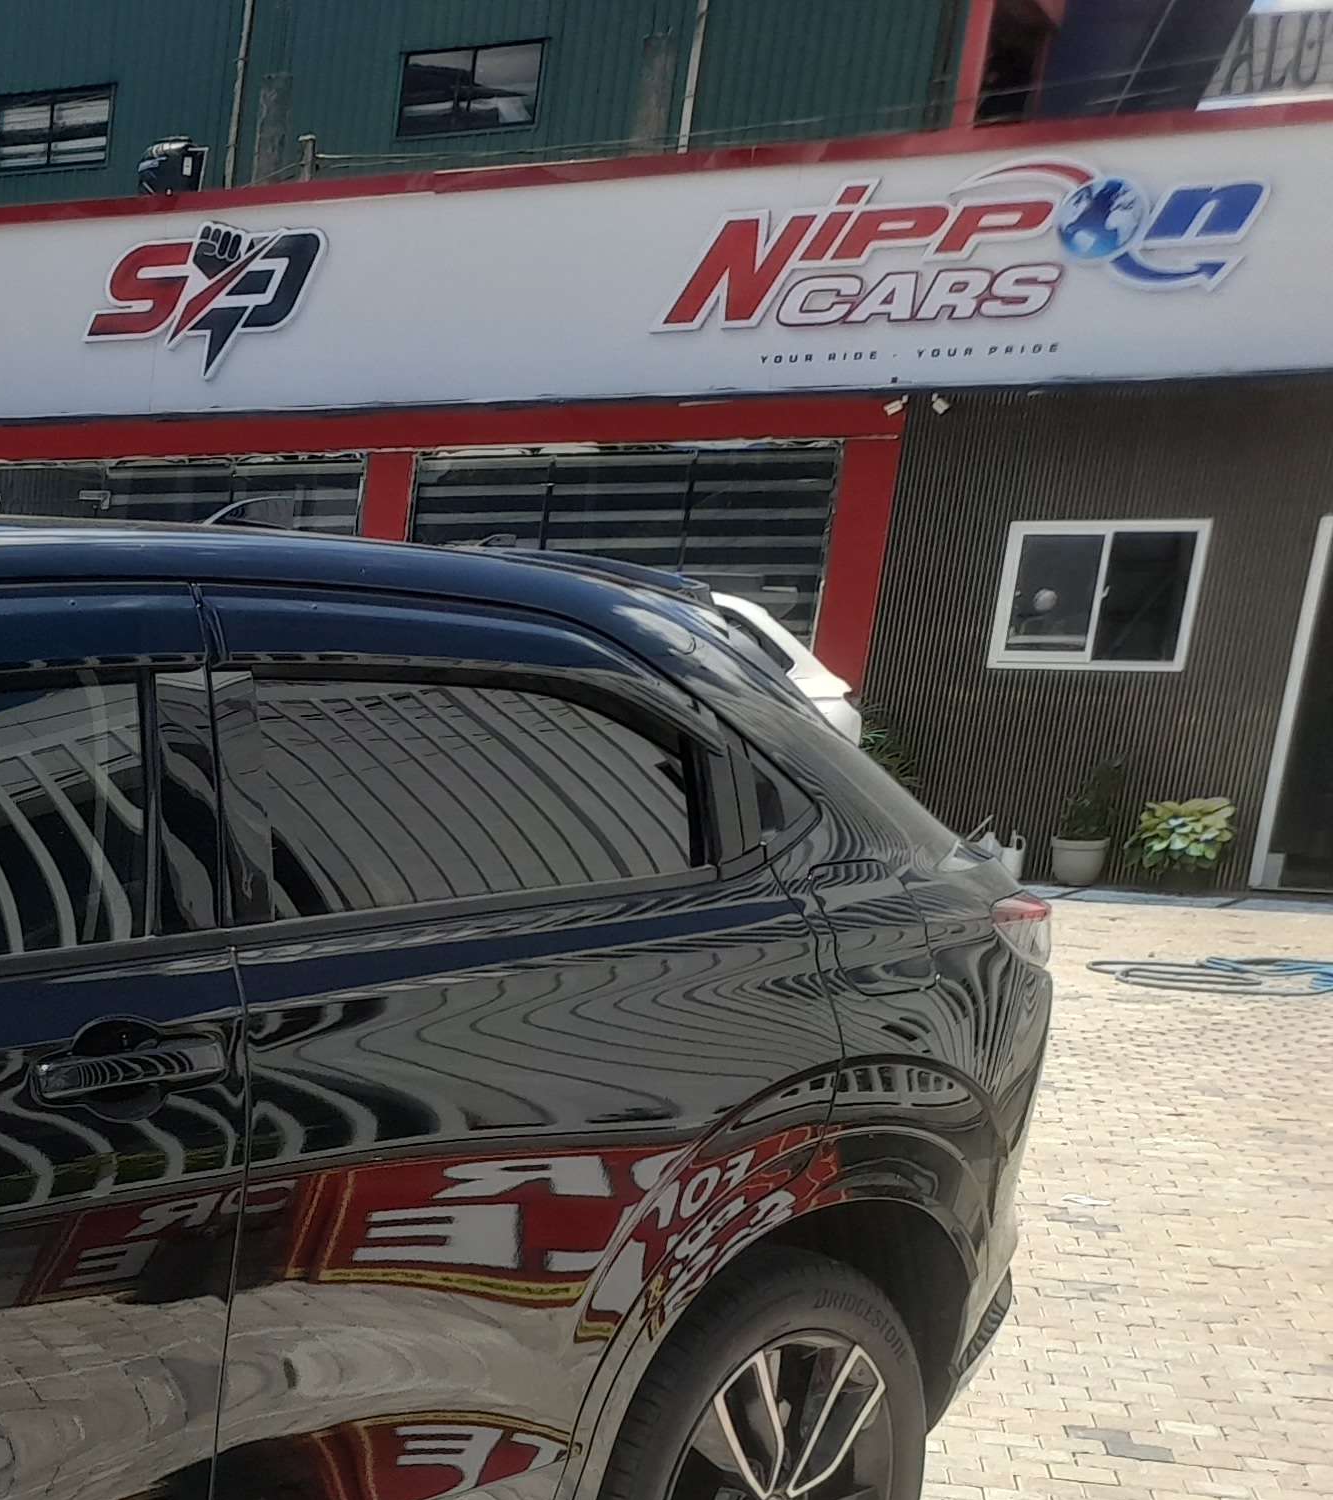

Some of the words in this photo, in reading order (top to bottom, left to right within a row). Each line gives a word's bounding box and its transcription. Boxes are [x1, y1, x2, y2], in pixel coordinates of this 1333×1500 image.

[775, 263, 1065, 327] CARS
[760, 353, 813, 364] YOUR
[828, 350, 878, 362] RIDE
[917, 347, 973, 359] YOUR
[987, 342, 1060, 356] PRIDE
